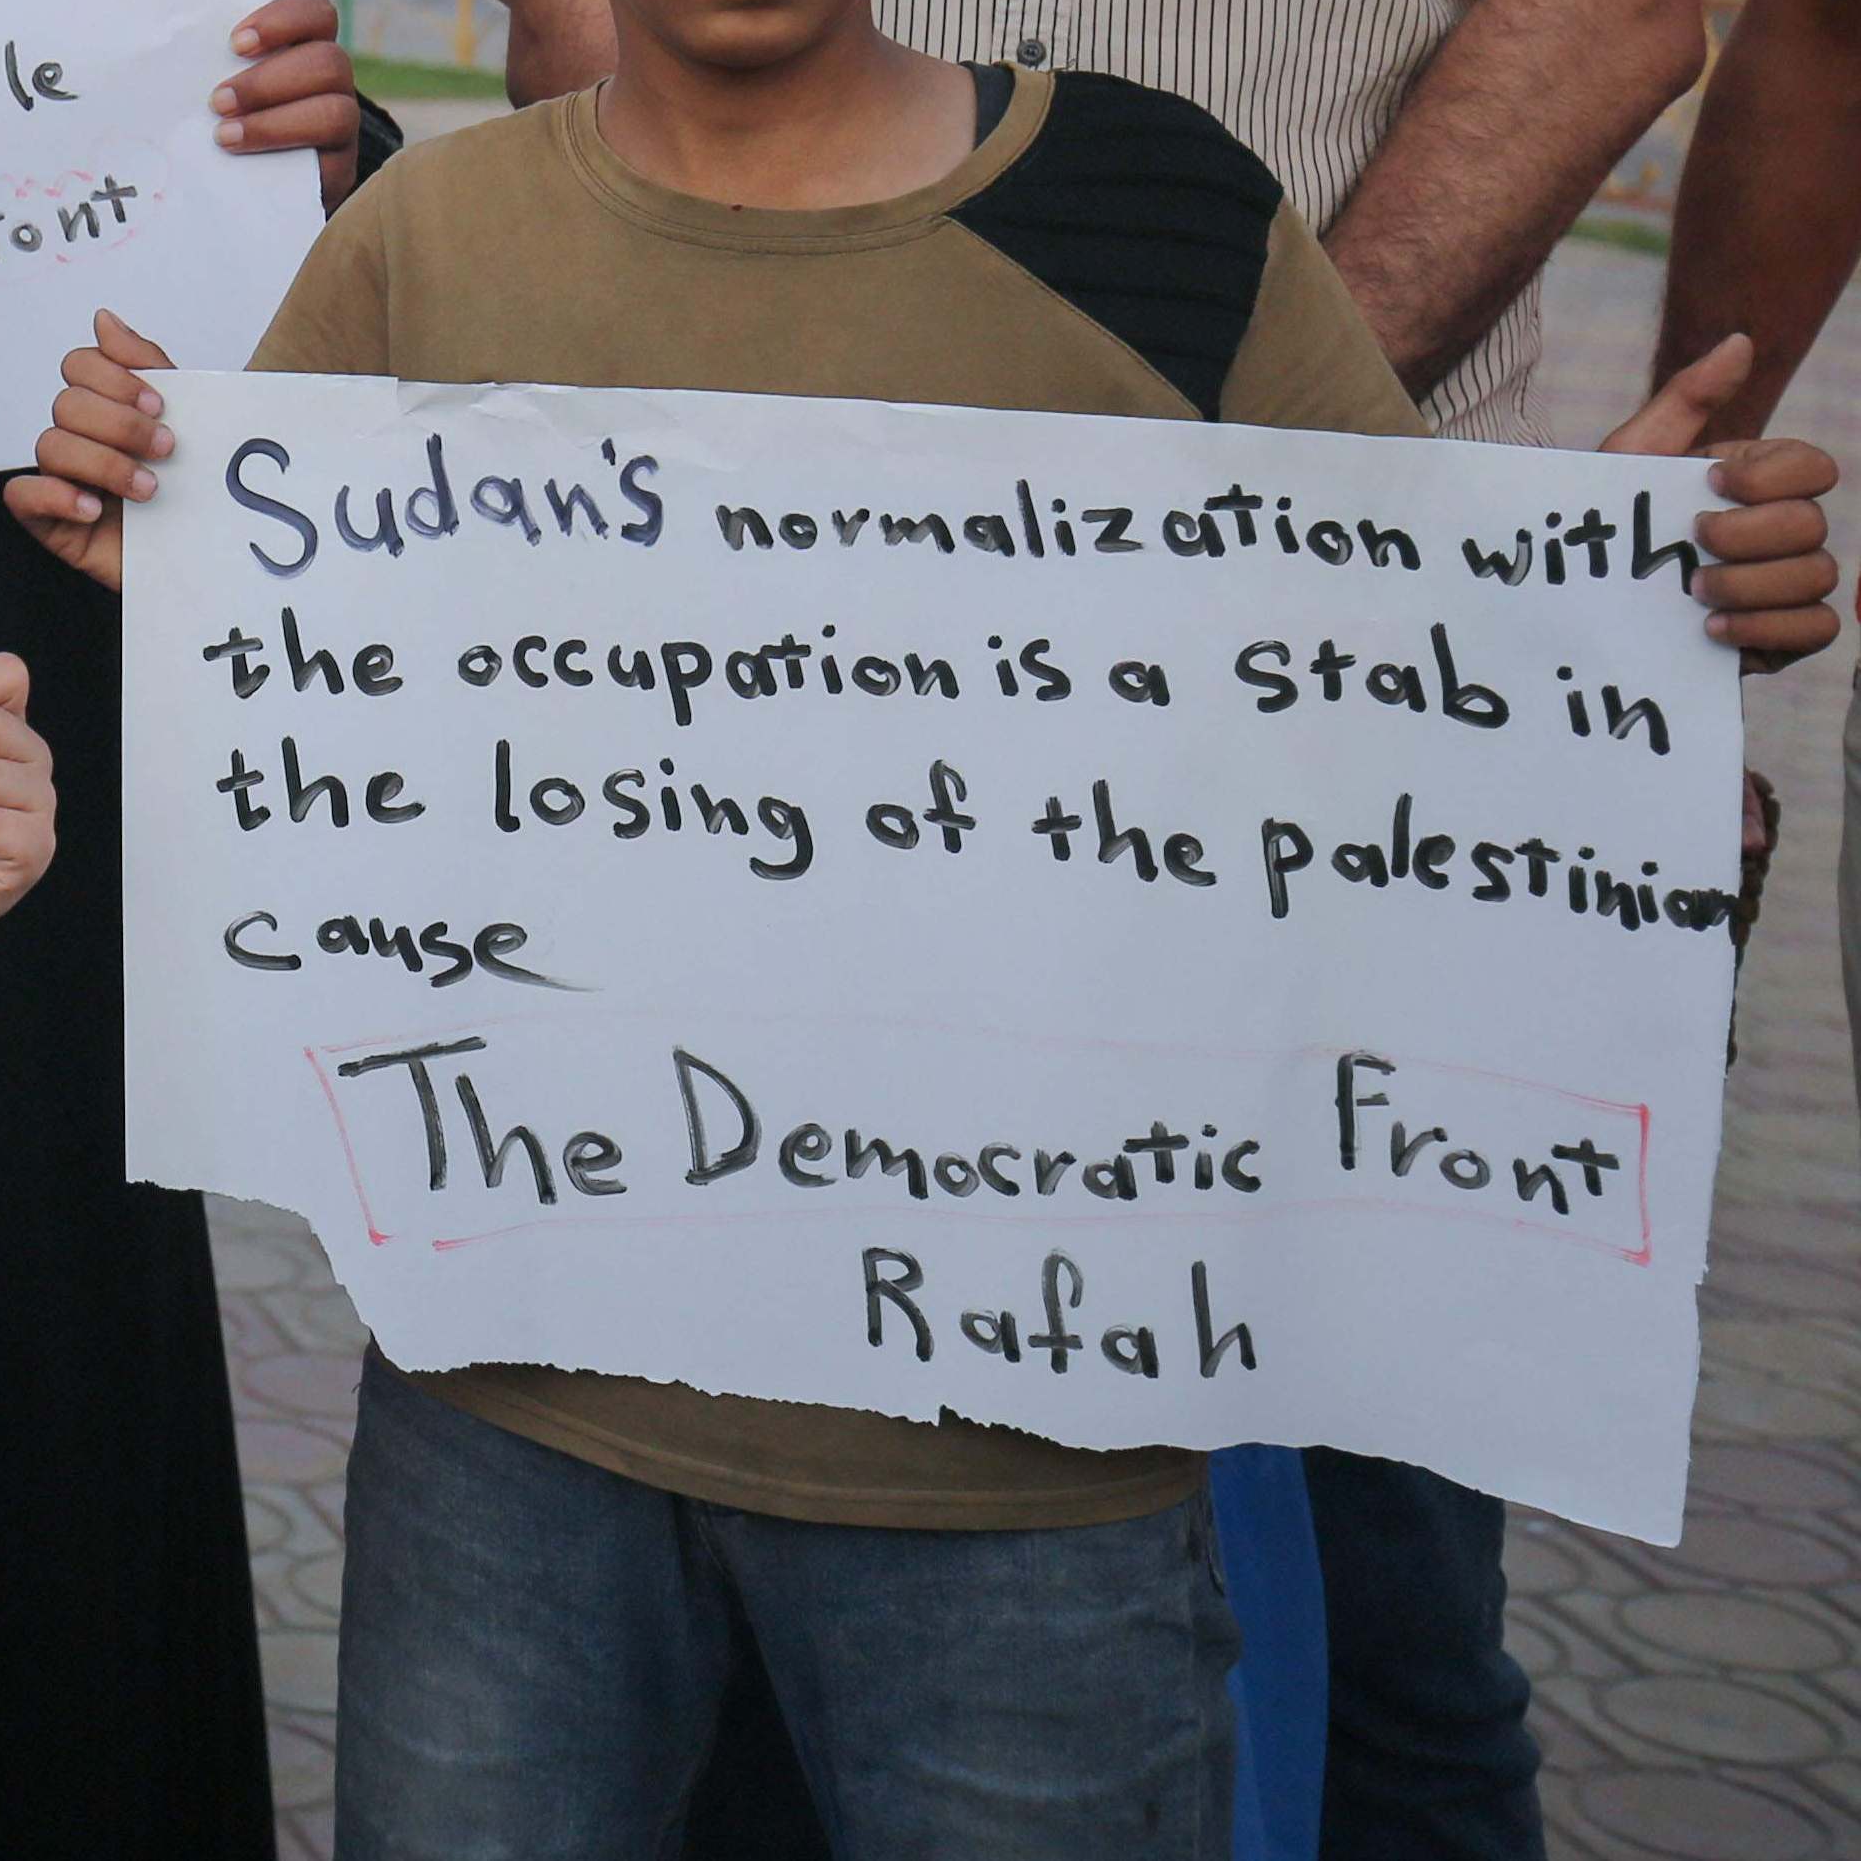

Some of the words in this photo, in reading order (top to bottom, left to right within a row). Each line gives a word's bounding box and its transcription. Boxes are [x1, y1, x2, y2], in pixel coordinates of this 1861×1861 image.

[226, 433, 664, 579] Sudan's
[715, 479, 1421, 571] normalization
[1461, 489, 1701, 595] with
[203, 606, 404, 700] the
[458, 624, 960, 727] occupation
[987, 635, 1071, 702] is
[1108, 661, 1171, 707] a
[1556, 666, 1670, 756] in
[216, 736, 426, 831] the
[495, 739, 813, 881] losing
[865, 759, 977, 854] of
[1031, 779, 1217, 887] the
[223, 911, 587, 991] cause
[337, 1036, 627, 1205] The
[673, 1045, 1262, 1201] Democratic
[1335, 1052, 1620, 1215] Front
[862, 1247, 1257, 1379] Rafah
